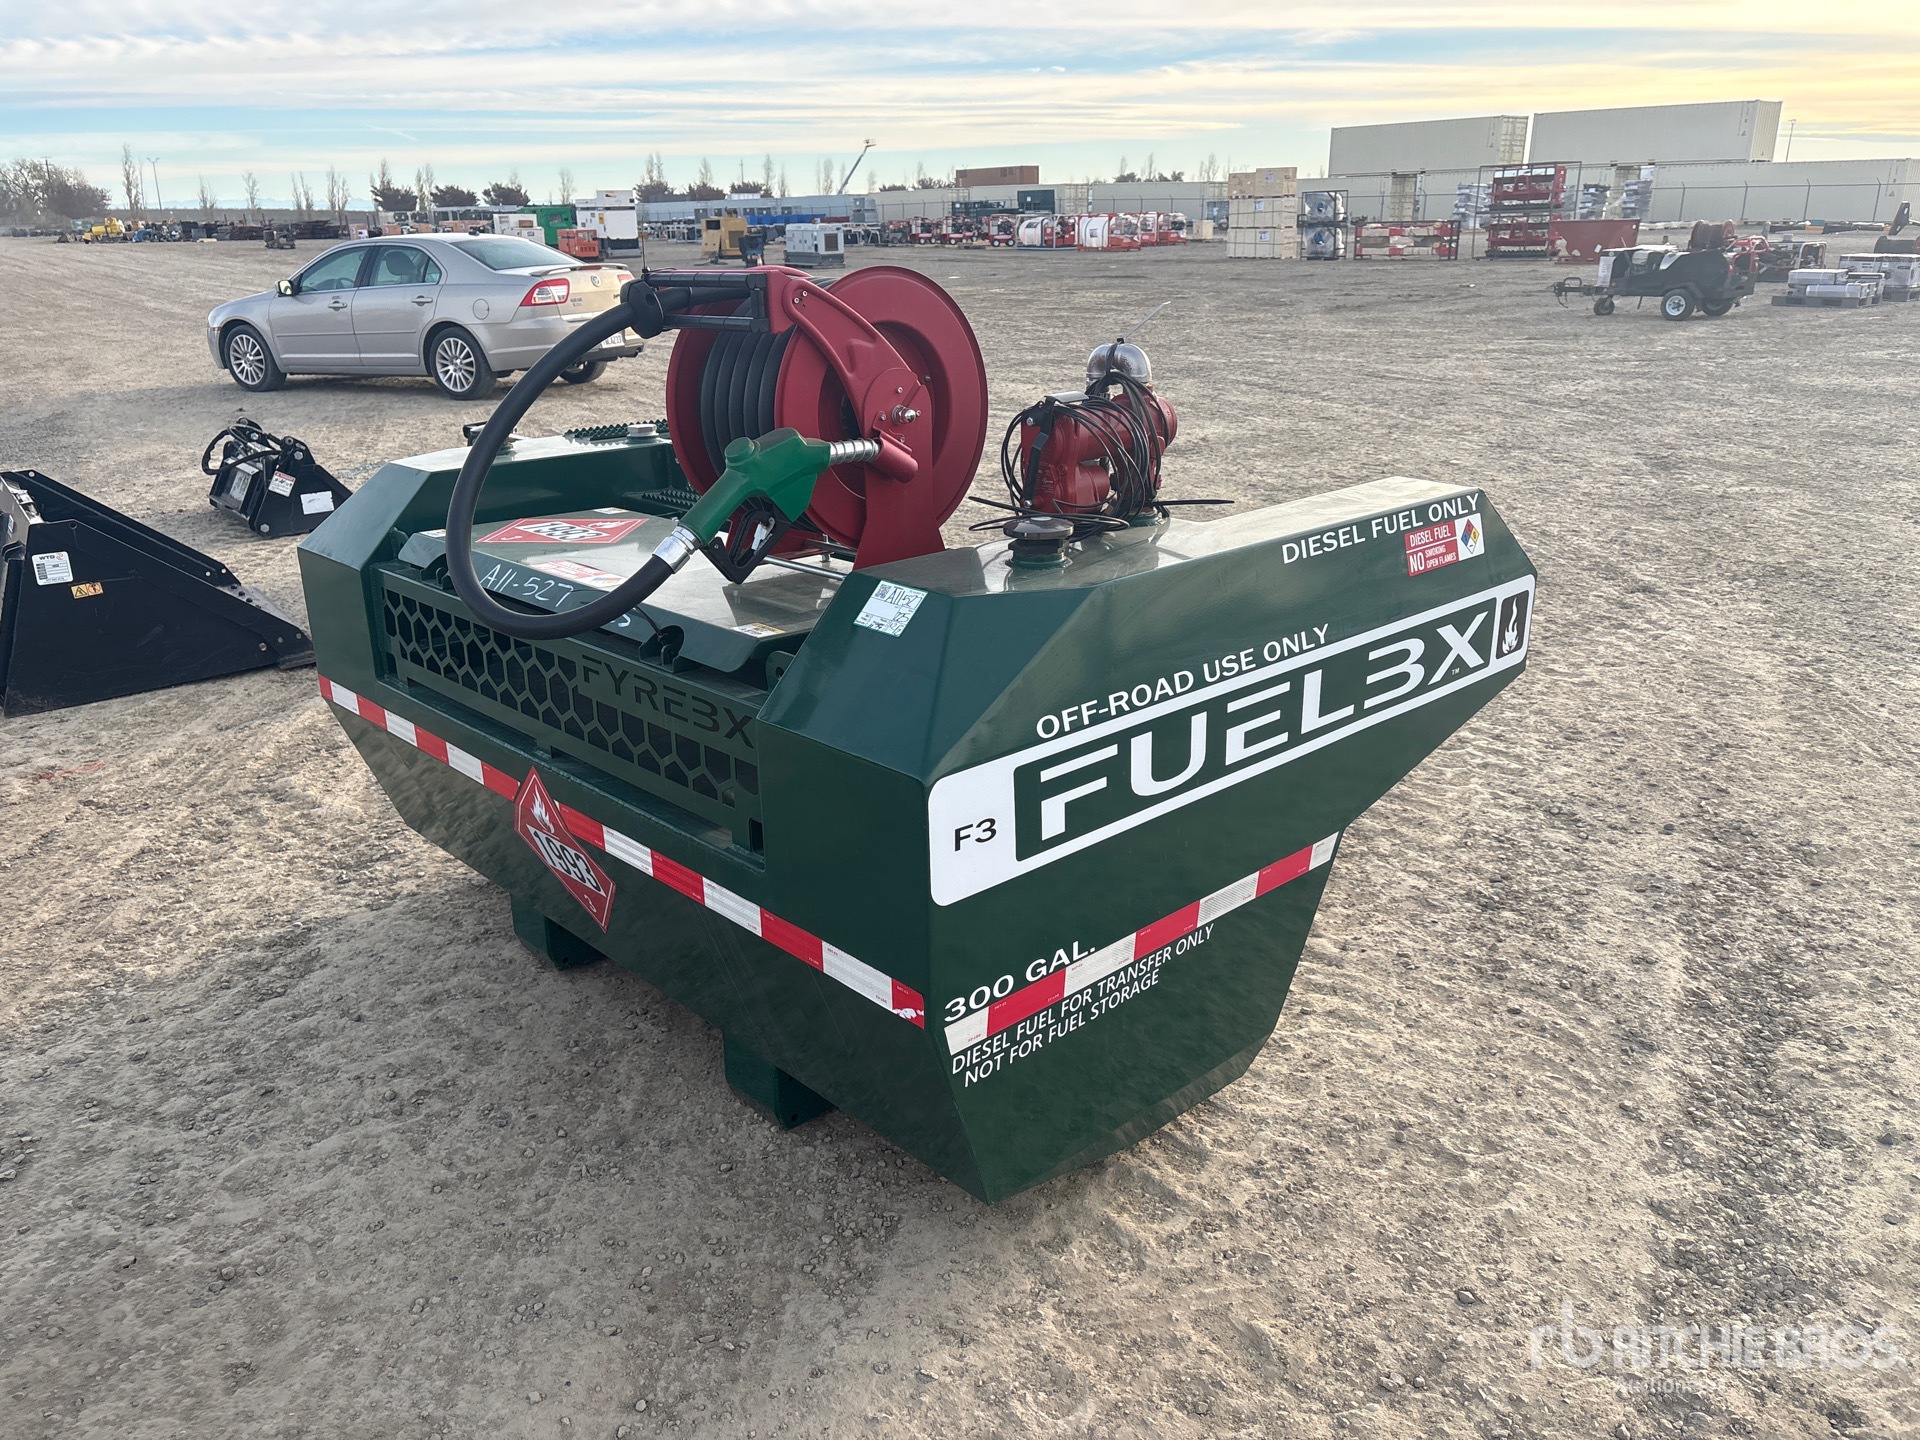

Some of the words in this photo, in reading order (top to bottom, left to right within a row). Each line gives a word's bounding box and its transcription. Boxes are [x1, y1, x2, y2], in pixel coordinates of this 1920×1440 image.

[1282, 525, 1366, 564] DIESEL
[1371, 509, 1424, 539] FUEL
[1428, 493, 1479, 522] ONLY
[1409, 530, 1434, 547] DIESEL
[1434, 524, 1451, 540] FUEL
[1424, 544, 1446, 558] SMOKING
[1409, 552, 1425, 573] NO
[1426, 557, 1439, 569] OPEN
[1439, 552, 1457, 565] FLAMES
[1036, 670, 1195, 739] OFF-ROAD
[1203, 648, 1257, 683] USE
[1263, 623, 1329, 662] ONLY
[954, 817, 997, 852] F3
[533, 831, 601, 892] 1993
[583, 894, 597, 913] 3
[944, 975, 1015, 1022] 300
[1025, 940, 1096, 982] GAL.
[952, 1031, 1011, 1074] DIESEL
[1016, 1008, 1056, 1041] FUEL
[1061, 987, 1092, 1018] FOR
[1097, 946, 1172, 998] TRANSFER
[1175, 923, 1214, 956] ONLY
[964, 1053, 1005, 1088] NOT
[1009, 1033, 1043, 1065] FOR
[1048, 1014, 1086, 1043] FUEL
[1090, 968, 1160, 1021] STORAGE
